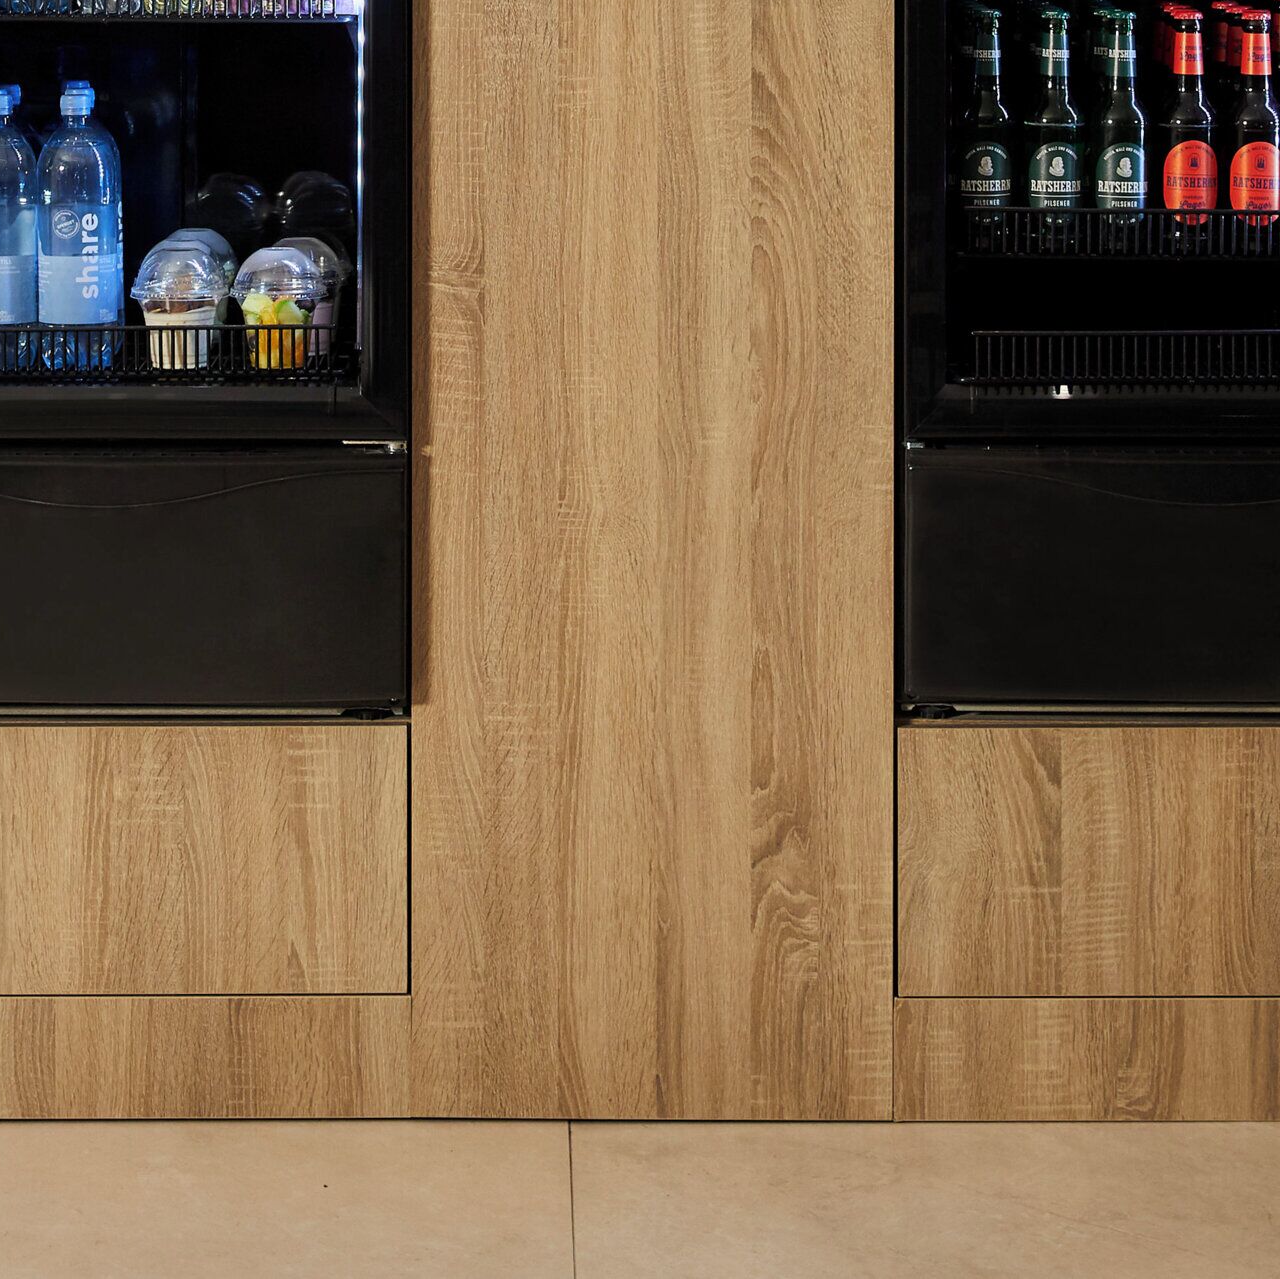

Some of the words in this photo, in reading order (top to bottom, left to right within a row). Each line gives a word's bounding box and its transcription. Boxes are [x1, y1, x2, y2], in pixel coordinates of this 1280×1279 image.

[961, 179, 1011, 192] RATSHERRN
[1031, 179, 1081, 192] RATSHERRN
[1097, 180, 1148, 193] RATSHERRN
[1167, 176, 1217, 188] RATSHERRN
[1044, 199, 1070, 207] PILSENER
[75, 212, 99, 300] share
